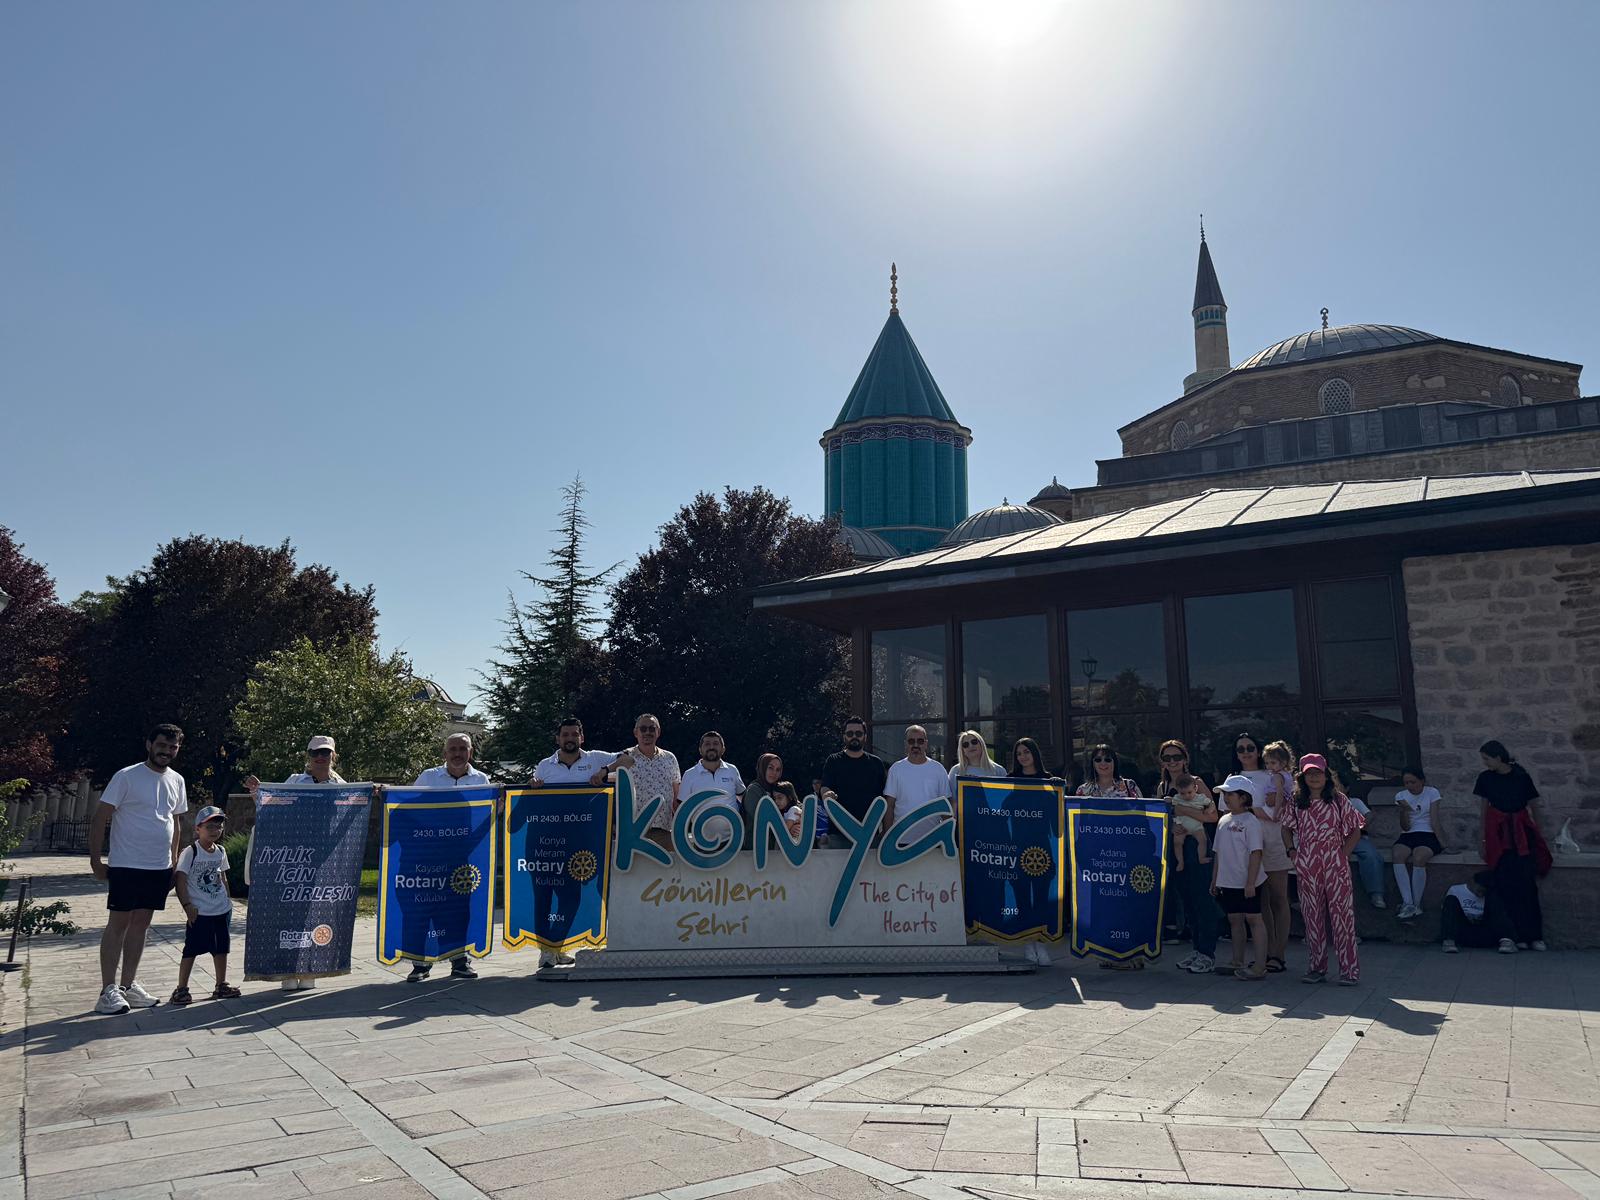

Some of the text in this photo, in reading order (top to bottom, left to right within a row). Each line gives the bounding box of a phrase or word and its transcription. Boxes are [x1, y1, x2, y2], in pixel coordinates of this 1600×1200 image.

[526, 813, 592, 823] UR 2430. BÖLGE
[977, 807, 1043, 818] UR 2430. BÖLGE
[413, 828, 469, 838] 2430. BÖLGE
[1093, 826, 1113, 834] 2430
[1116, 826, 1146, 835] BÖLGE
[539, 836, 566, 847] Konya
[975, 840, 1017, 853] Osmaniye
[259, 845, 315, 864] İYİLİK
[534, 849, 565, 858] Meram
[971, 850, 1017, 868] Rotary
[1100, 849, 1127, 857] Adana
[415, 863, 447, 875] Kayseri
[518, 859, 564, 874] Rotary
[275, 867, 316, 884] İÇİN
[988, 870, 1018, 880] Kulübü
[1082, 870, 1126, 885] Rotary
[395, 875, 446, 890] Rotary
[281, 883, 356, 903] BİRLEŞİN
[640, 877, 786, 906] Gönüllerin
[860, 881, 958, 912] The City of
[548, 913, 565, 921] 2004
[883, 911, 938, 934] Hearts
[676, 912, 749, 942] Şehri
[280, 930, 312, 942] Rotary
[1110, 930, 1130, 938] 2019
